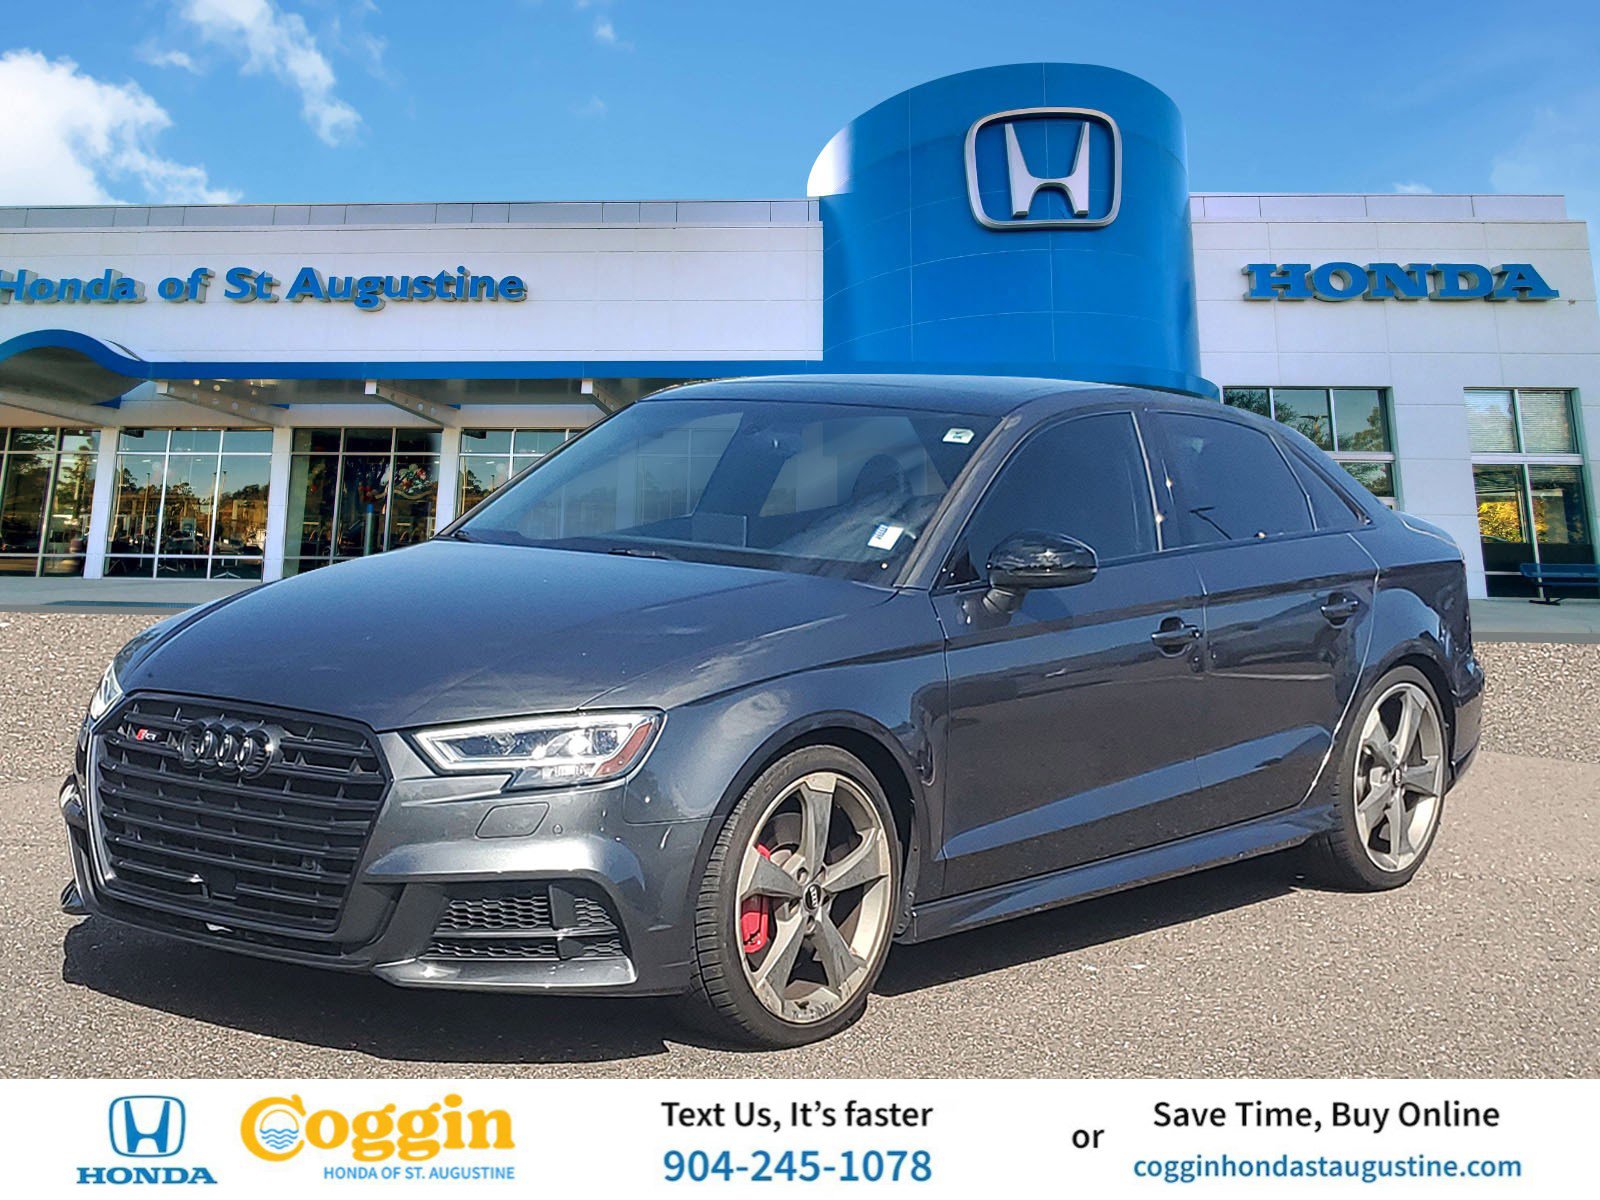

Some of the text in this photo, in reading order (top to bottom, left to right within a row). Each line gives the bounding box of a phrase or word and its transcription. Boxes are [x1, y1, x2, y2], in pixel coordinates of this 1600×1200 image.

[0, 265, 527, 312] Honda of St Augustine
[1241, 262, 1559, 302] HONDA
